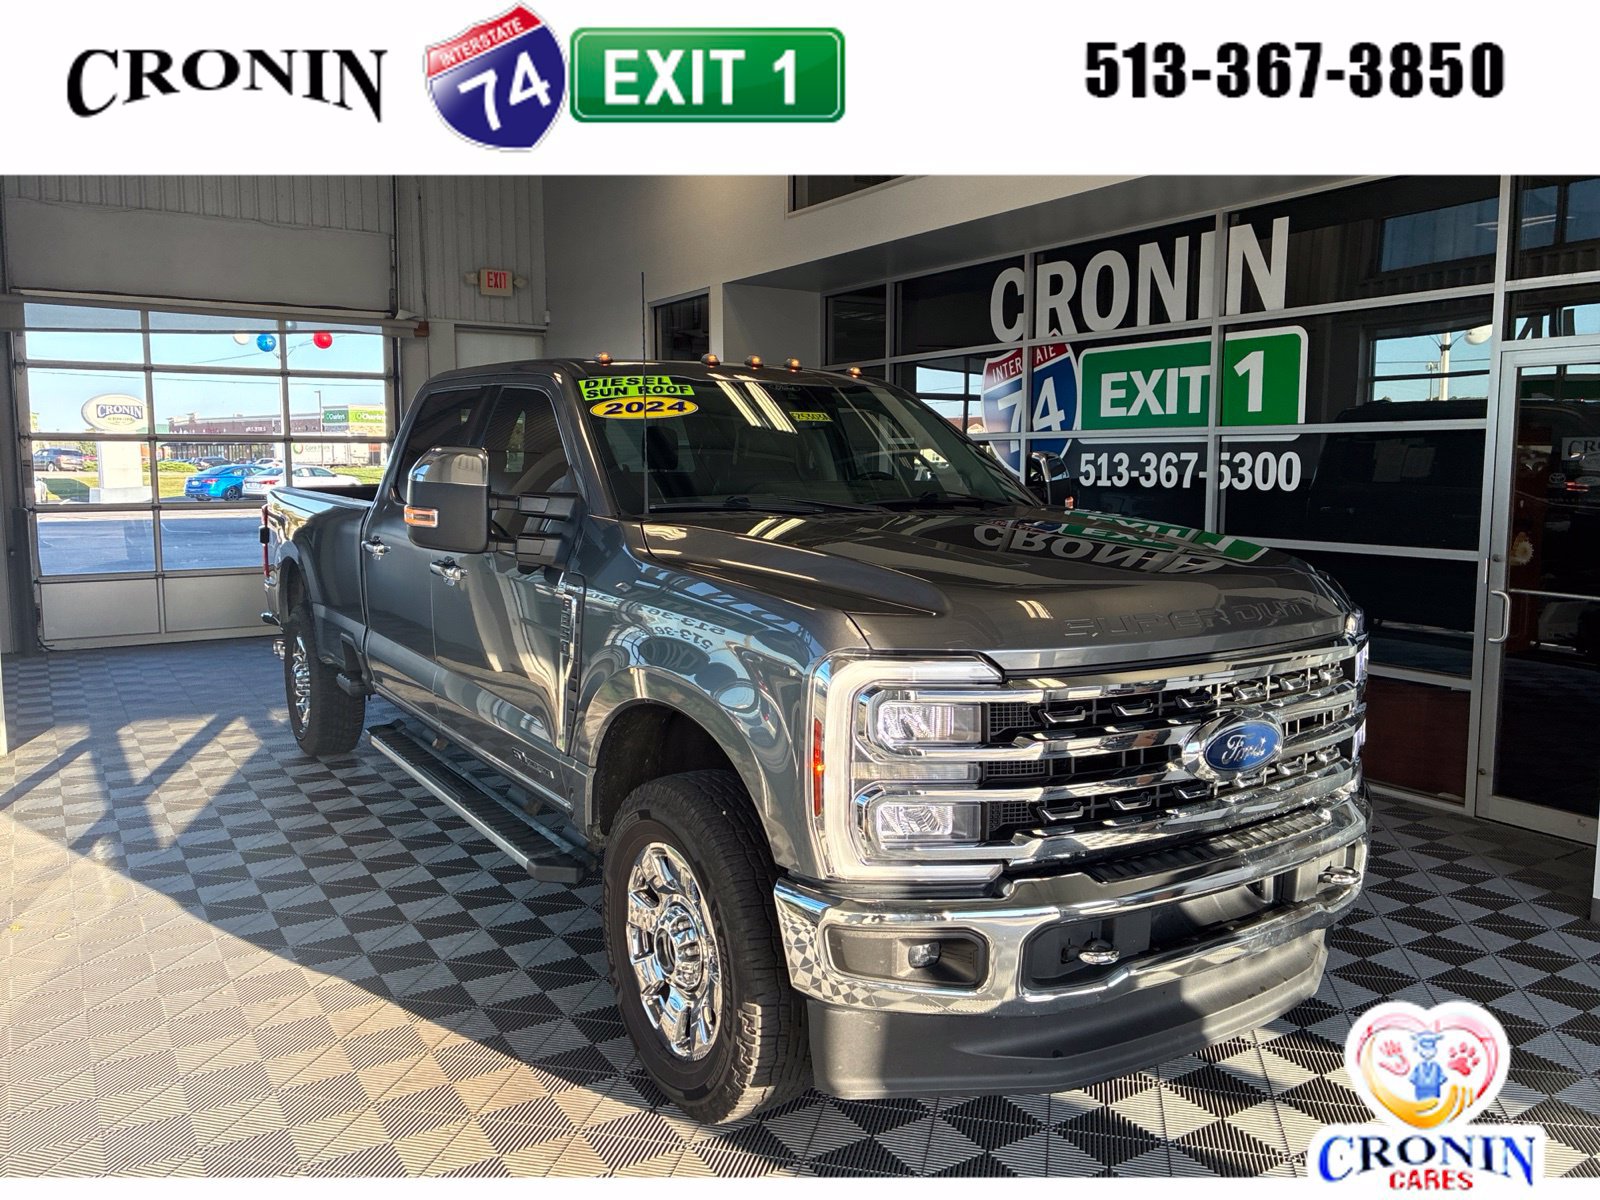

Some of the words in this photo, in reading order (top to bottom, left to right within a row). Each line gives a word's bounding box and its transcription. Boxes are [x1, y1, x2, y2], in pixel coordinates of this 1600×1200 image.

[486, 271, 507, 289] EXIT
[990, 216, 1290, 343] CRONIN
[992, 344, 1057, 384] INTERATE
[584, 376, 669, 389] DIESEL
[586, 387, 628, 398] SUN
[638, 385, 689, 395] ROOF
[1100, 365, 1211, 418] EXIT
[1233, 350, 1265, 413] 1
[97, 404, 143, 419] CRONIN
[603, 400, 687, 415] 2024
[997, 376, 1066, 454] 74
[1568, 440, 1600, 457] CR
[1078, 451, 1301, 492] 513-367-5300
[1063, 606, 1232, 638] SUPER
[1232, 594, 1319, 628] DUTY
[1221, 734, 1267, 765] Ford
